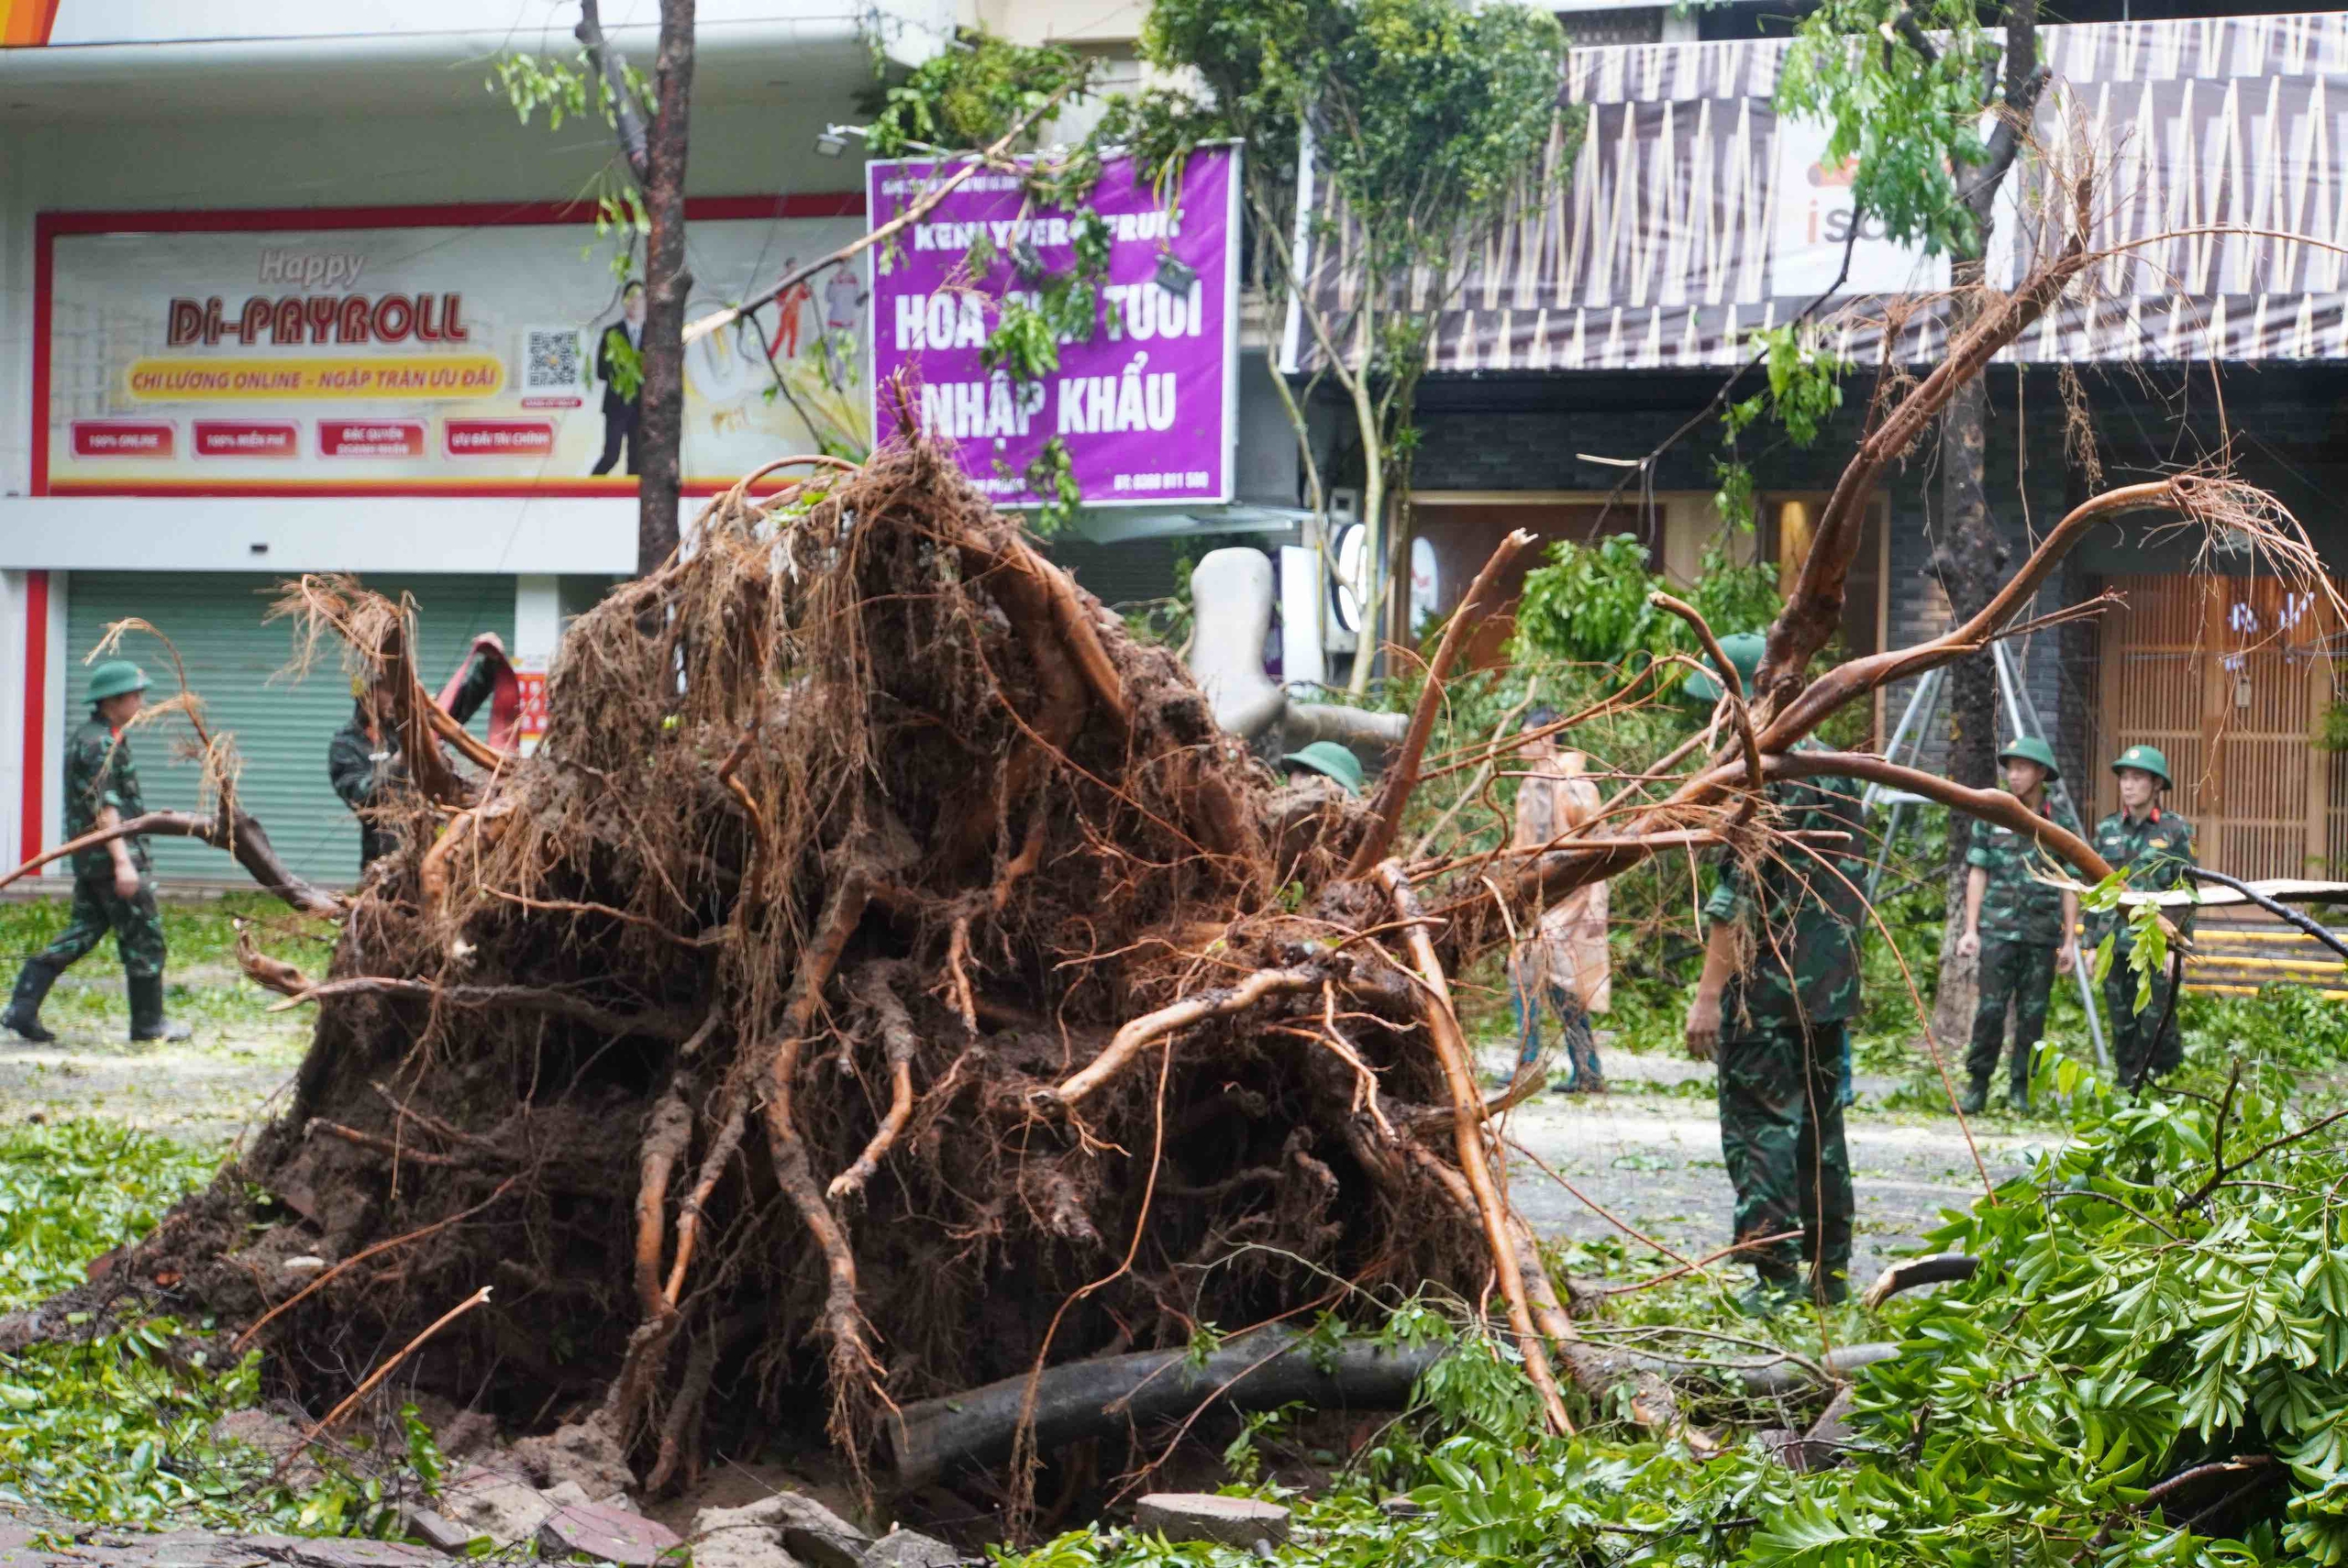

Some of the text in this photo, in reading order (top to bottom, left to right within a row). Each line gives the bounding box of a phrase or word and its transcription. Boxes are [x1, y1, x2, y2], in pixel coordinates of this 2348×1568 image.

[259, 248, 364, 288] Happy
[894, 291, 986, 351] HOA
[131, 370, 163, 391] CHI
[233, 370, 303, 391] ONLINE
[920, 350, 1178, 450] NHẬP KHẨU
